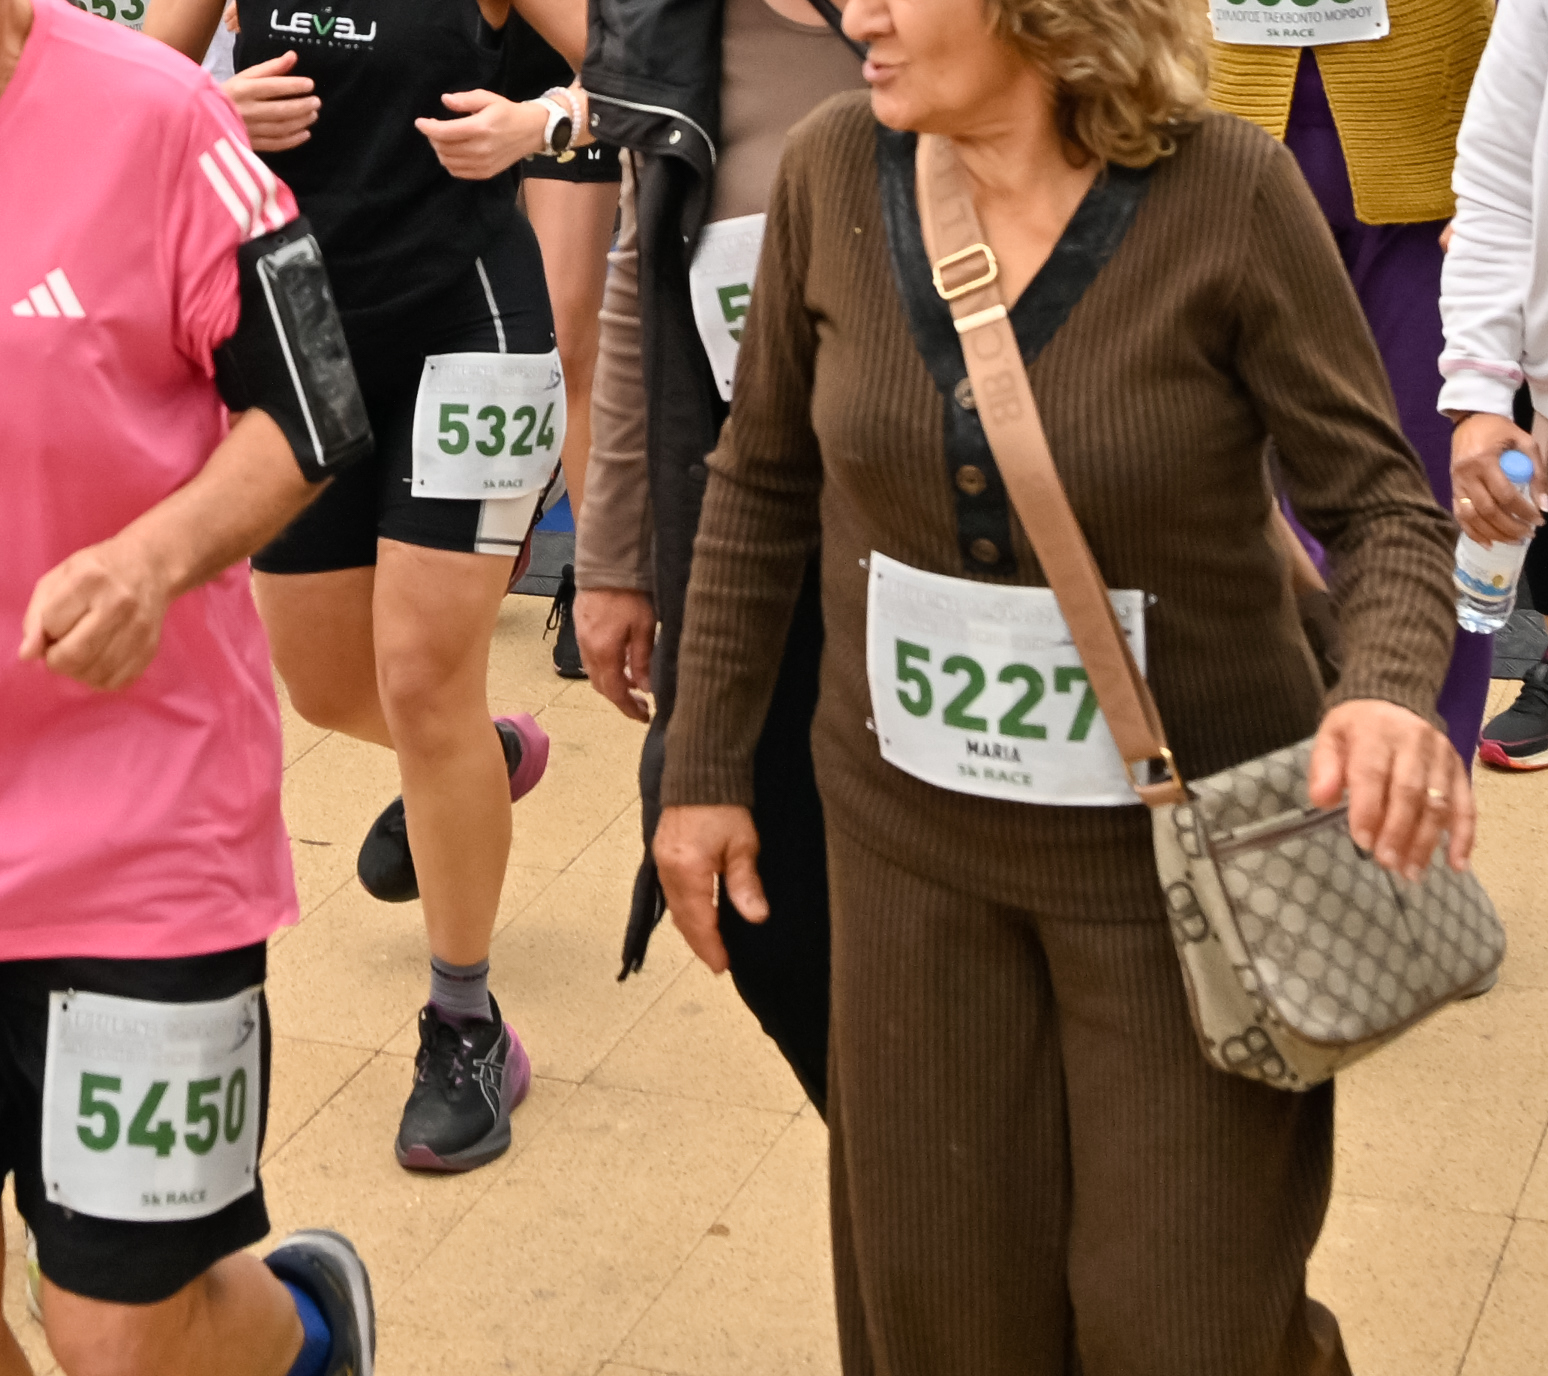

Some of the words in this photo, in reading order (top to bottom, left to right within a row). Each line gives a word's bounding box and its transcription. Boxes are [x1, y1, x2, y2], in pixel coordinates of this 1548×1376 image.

[270, 8, 377, 42] LEVEL
[1283, 28, 1315, 37] RACE
[437, 401, 555, 457] 5324
[498, 478, 524, 489] RACE
[894, 638, 1101, 742] 5227
[966, 739, 1022, 763] MARIA
[984, 765, 1033, 787] RACE
[76, 1066, 247, 1159] 5450
[166, 1190, 208, 1206] RACE
